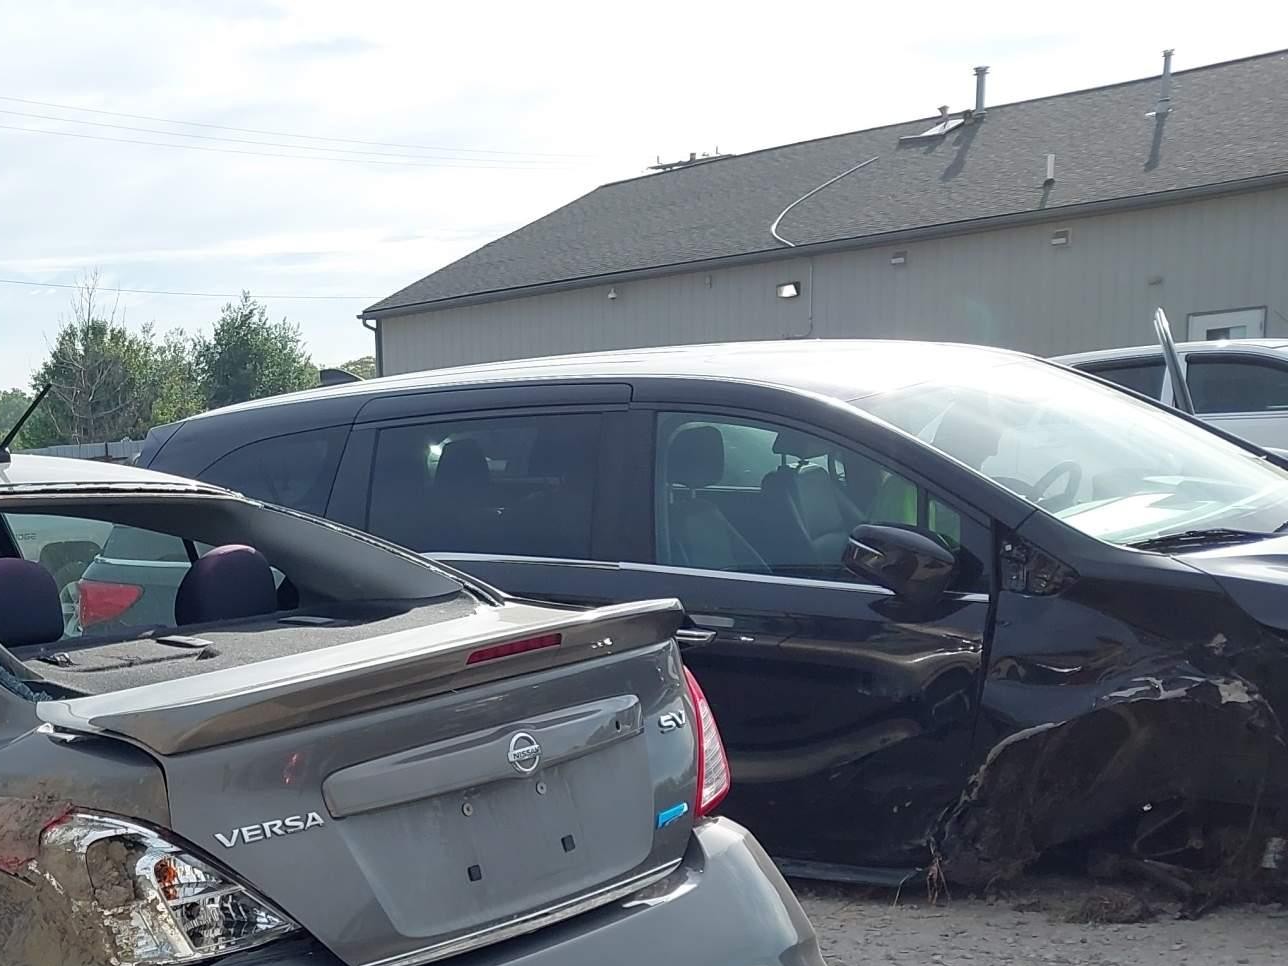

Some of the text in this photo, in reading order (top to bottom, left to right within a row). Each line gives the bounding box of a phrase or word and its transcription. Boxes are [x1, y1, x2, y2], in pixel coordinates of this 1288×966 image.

[658, 710, 686, 731] SV
[512, 746, 540, 760] NISSAN
[214, 811, 324, 848] VERSA
